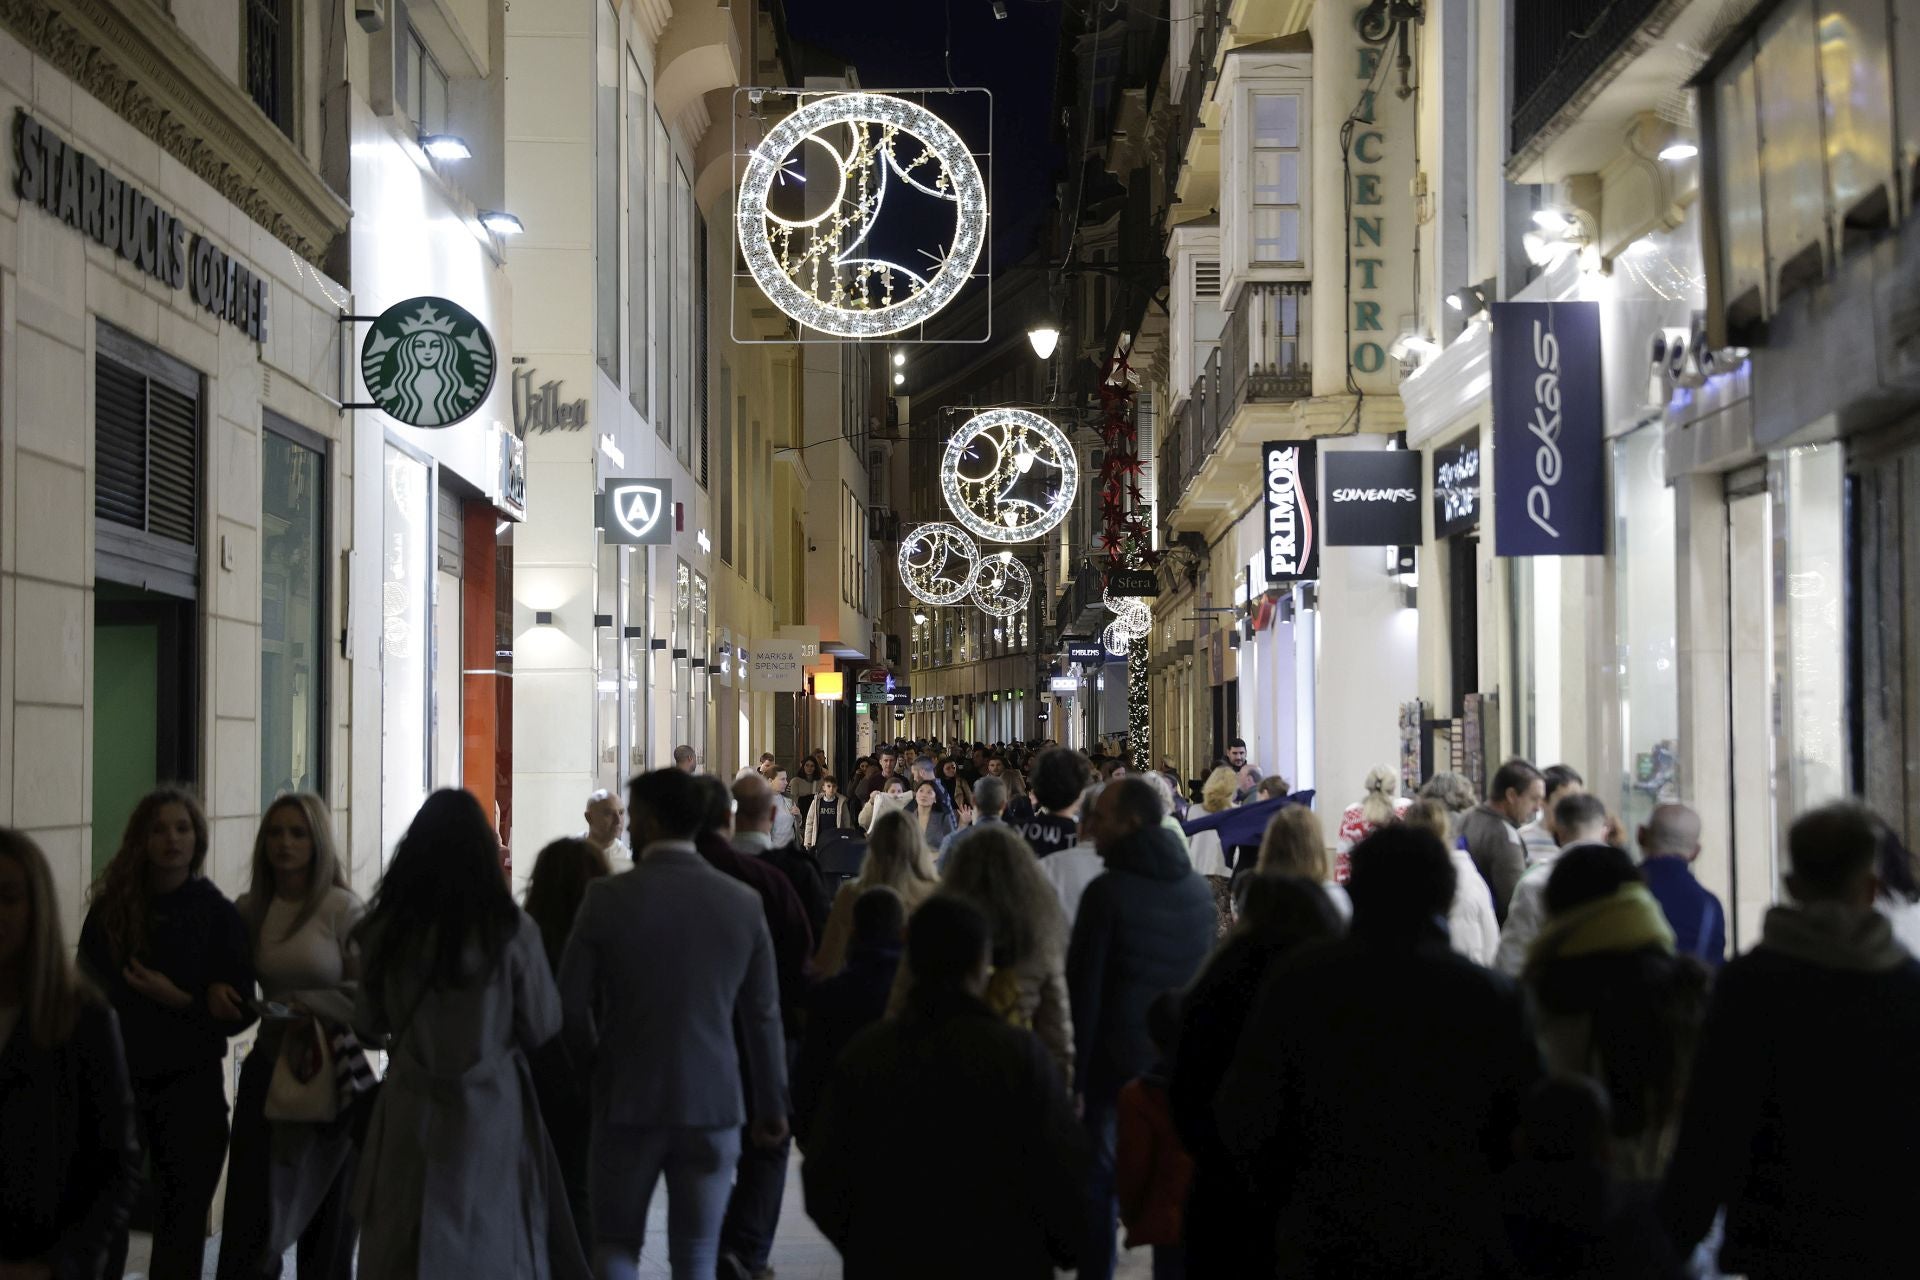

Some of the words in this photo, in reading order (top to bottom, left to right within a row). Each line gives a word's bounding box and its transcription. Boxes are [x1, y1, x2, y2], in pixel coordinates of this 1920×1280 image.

[17, 110, 185, 290] STARBUCKS
[193, 235, 268, 343] COFFEE
[1269, 446, 1297, 576] PRIMOR
[756, 652, 787, 661] MARKS
[788, 652, 794, 661] &
[1071, 649, 1100, 657] EMBLEMS
[755, 662, 796, 670] SPENCER
